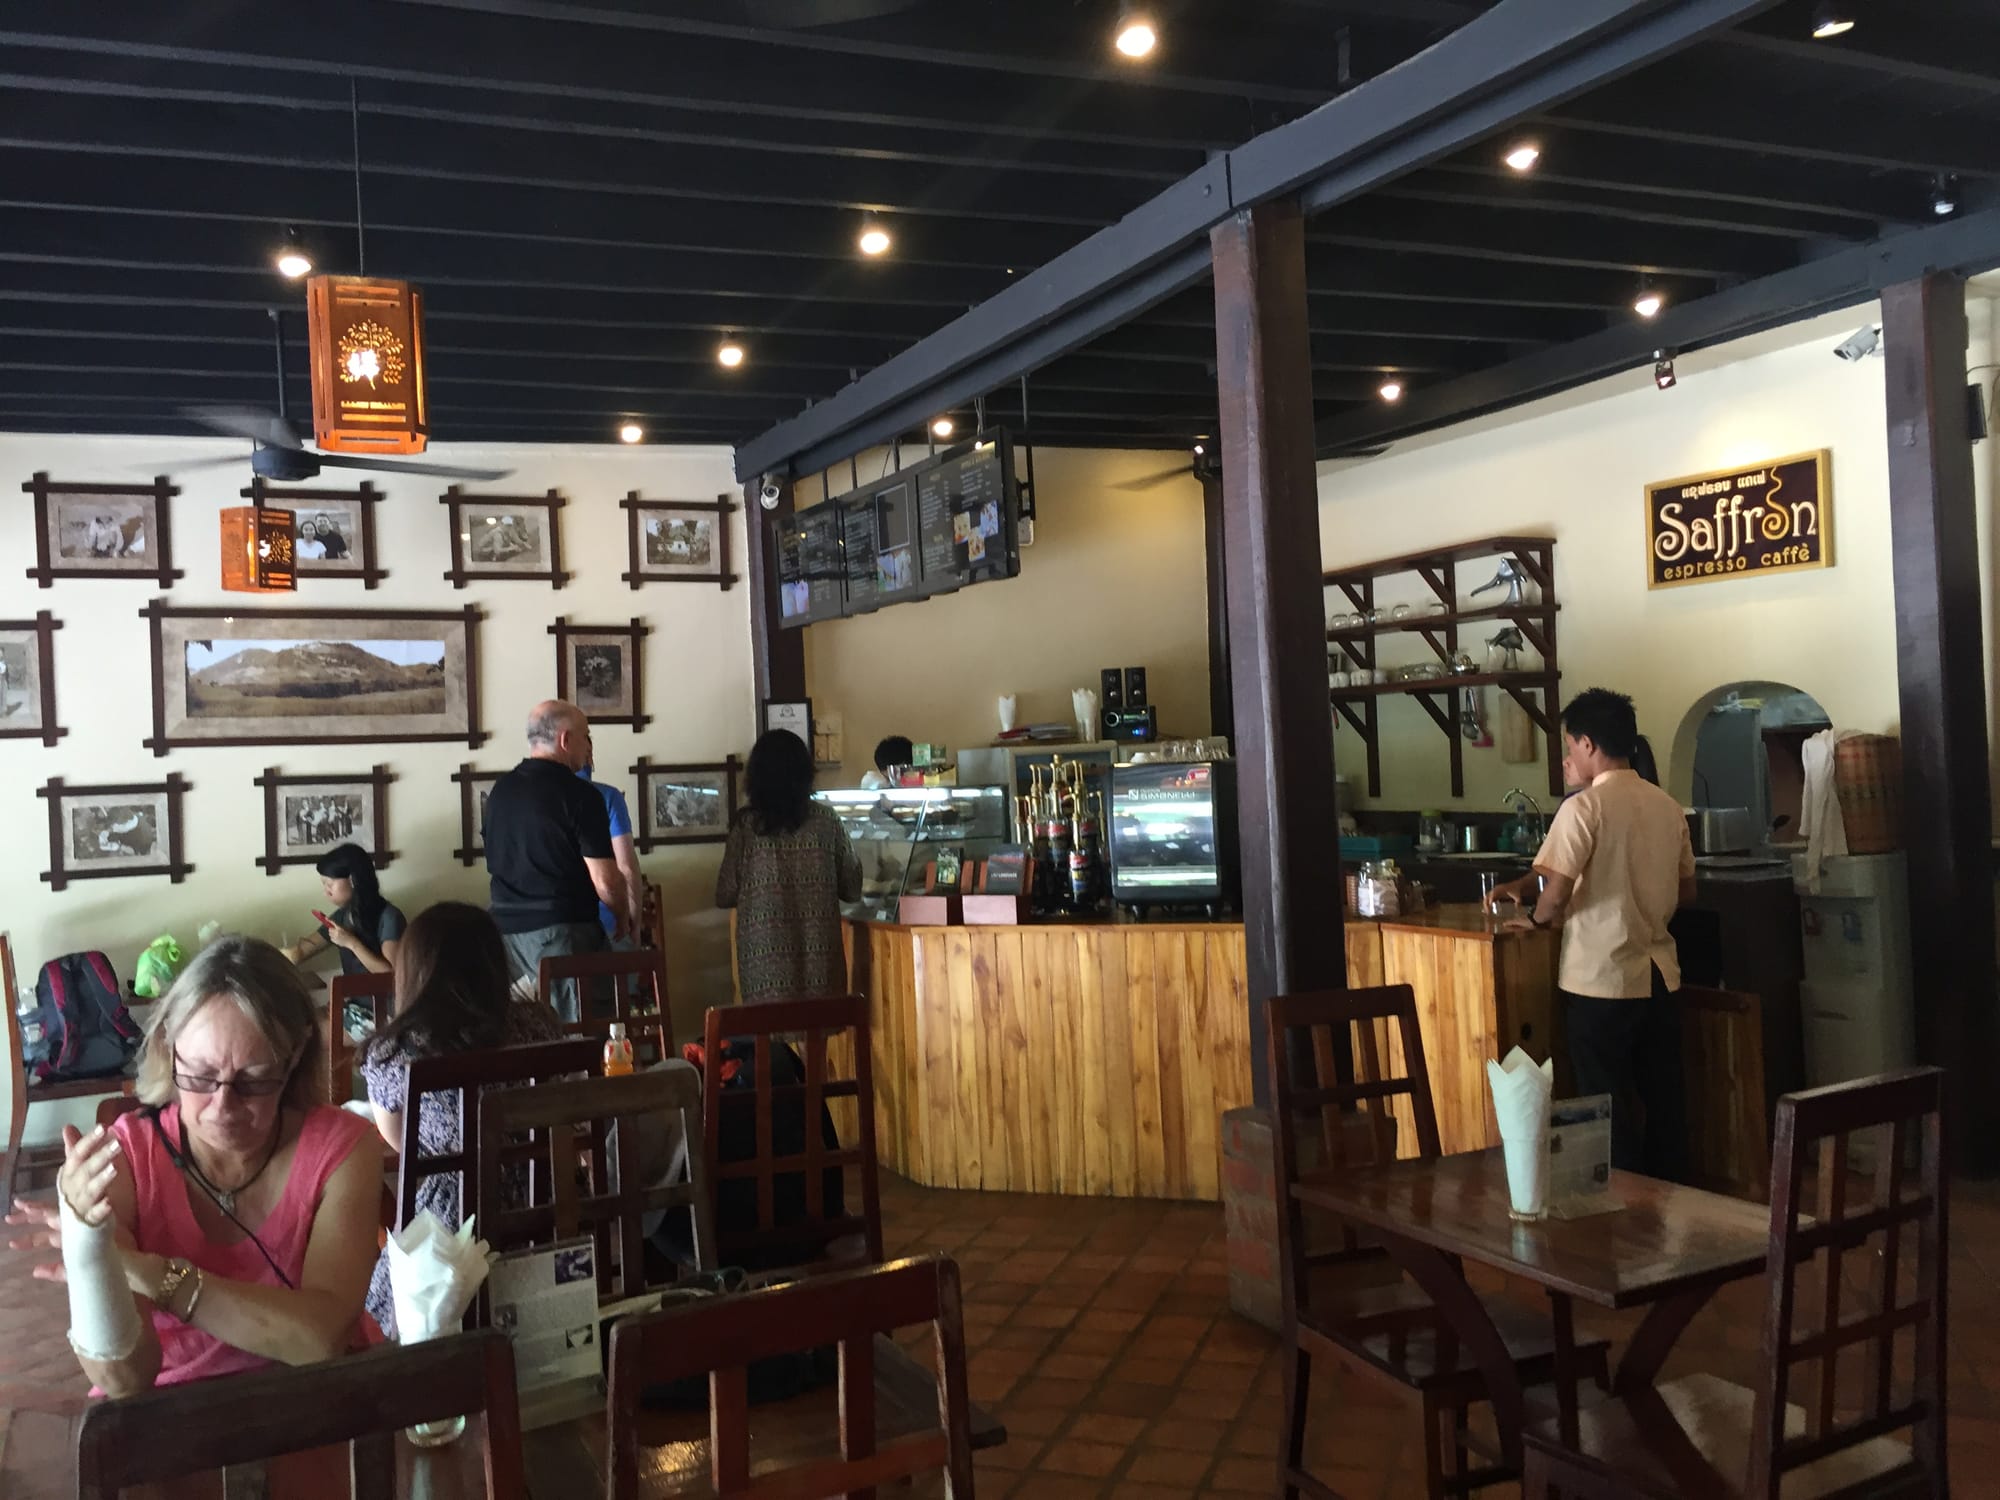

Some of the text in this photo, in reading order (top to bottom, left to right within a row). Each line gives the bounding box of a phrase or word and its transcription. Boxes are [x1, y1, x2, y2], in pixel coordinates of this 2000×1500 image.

[1654, 493, 1817, 561] Saffron
[1664, 543, 1810, 579] espresso caffè
